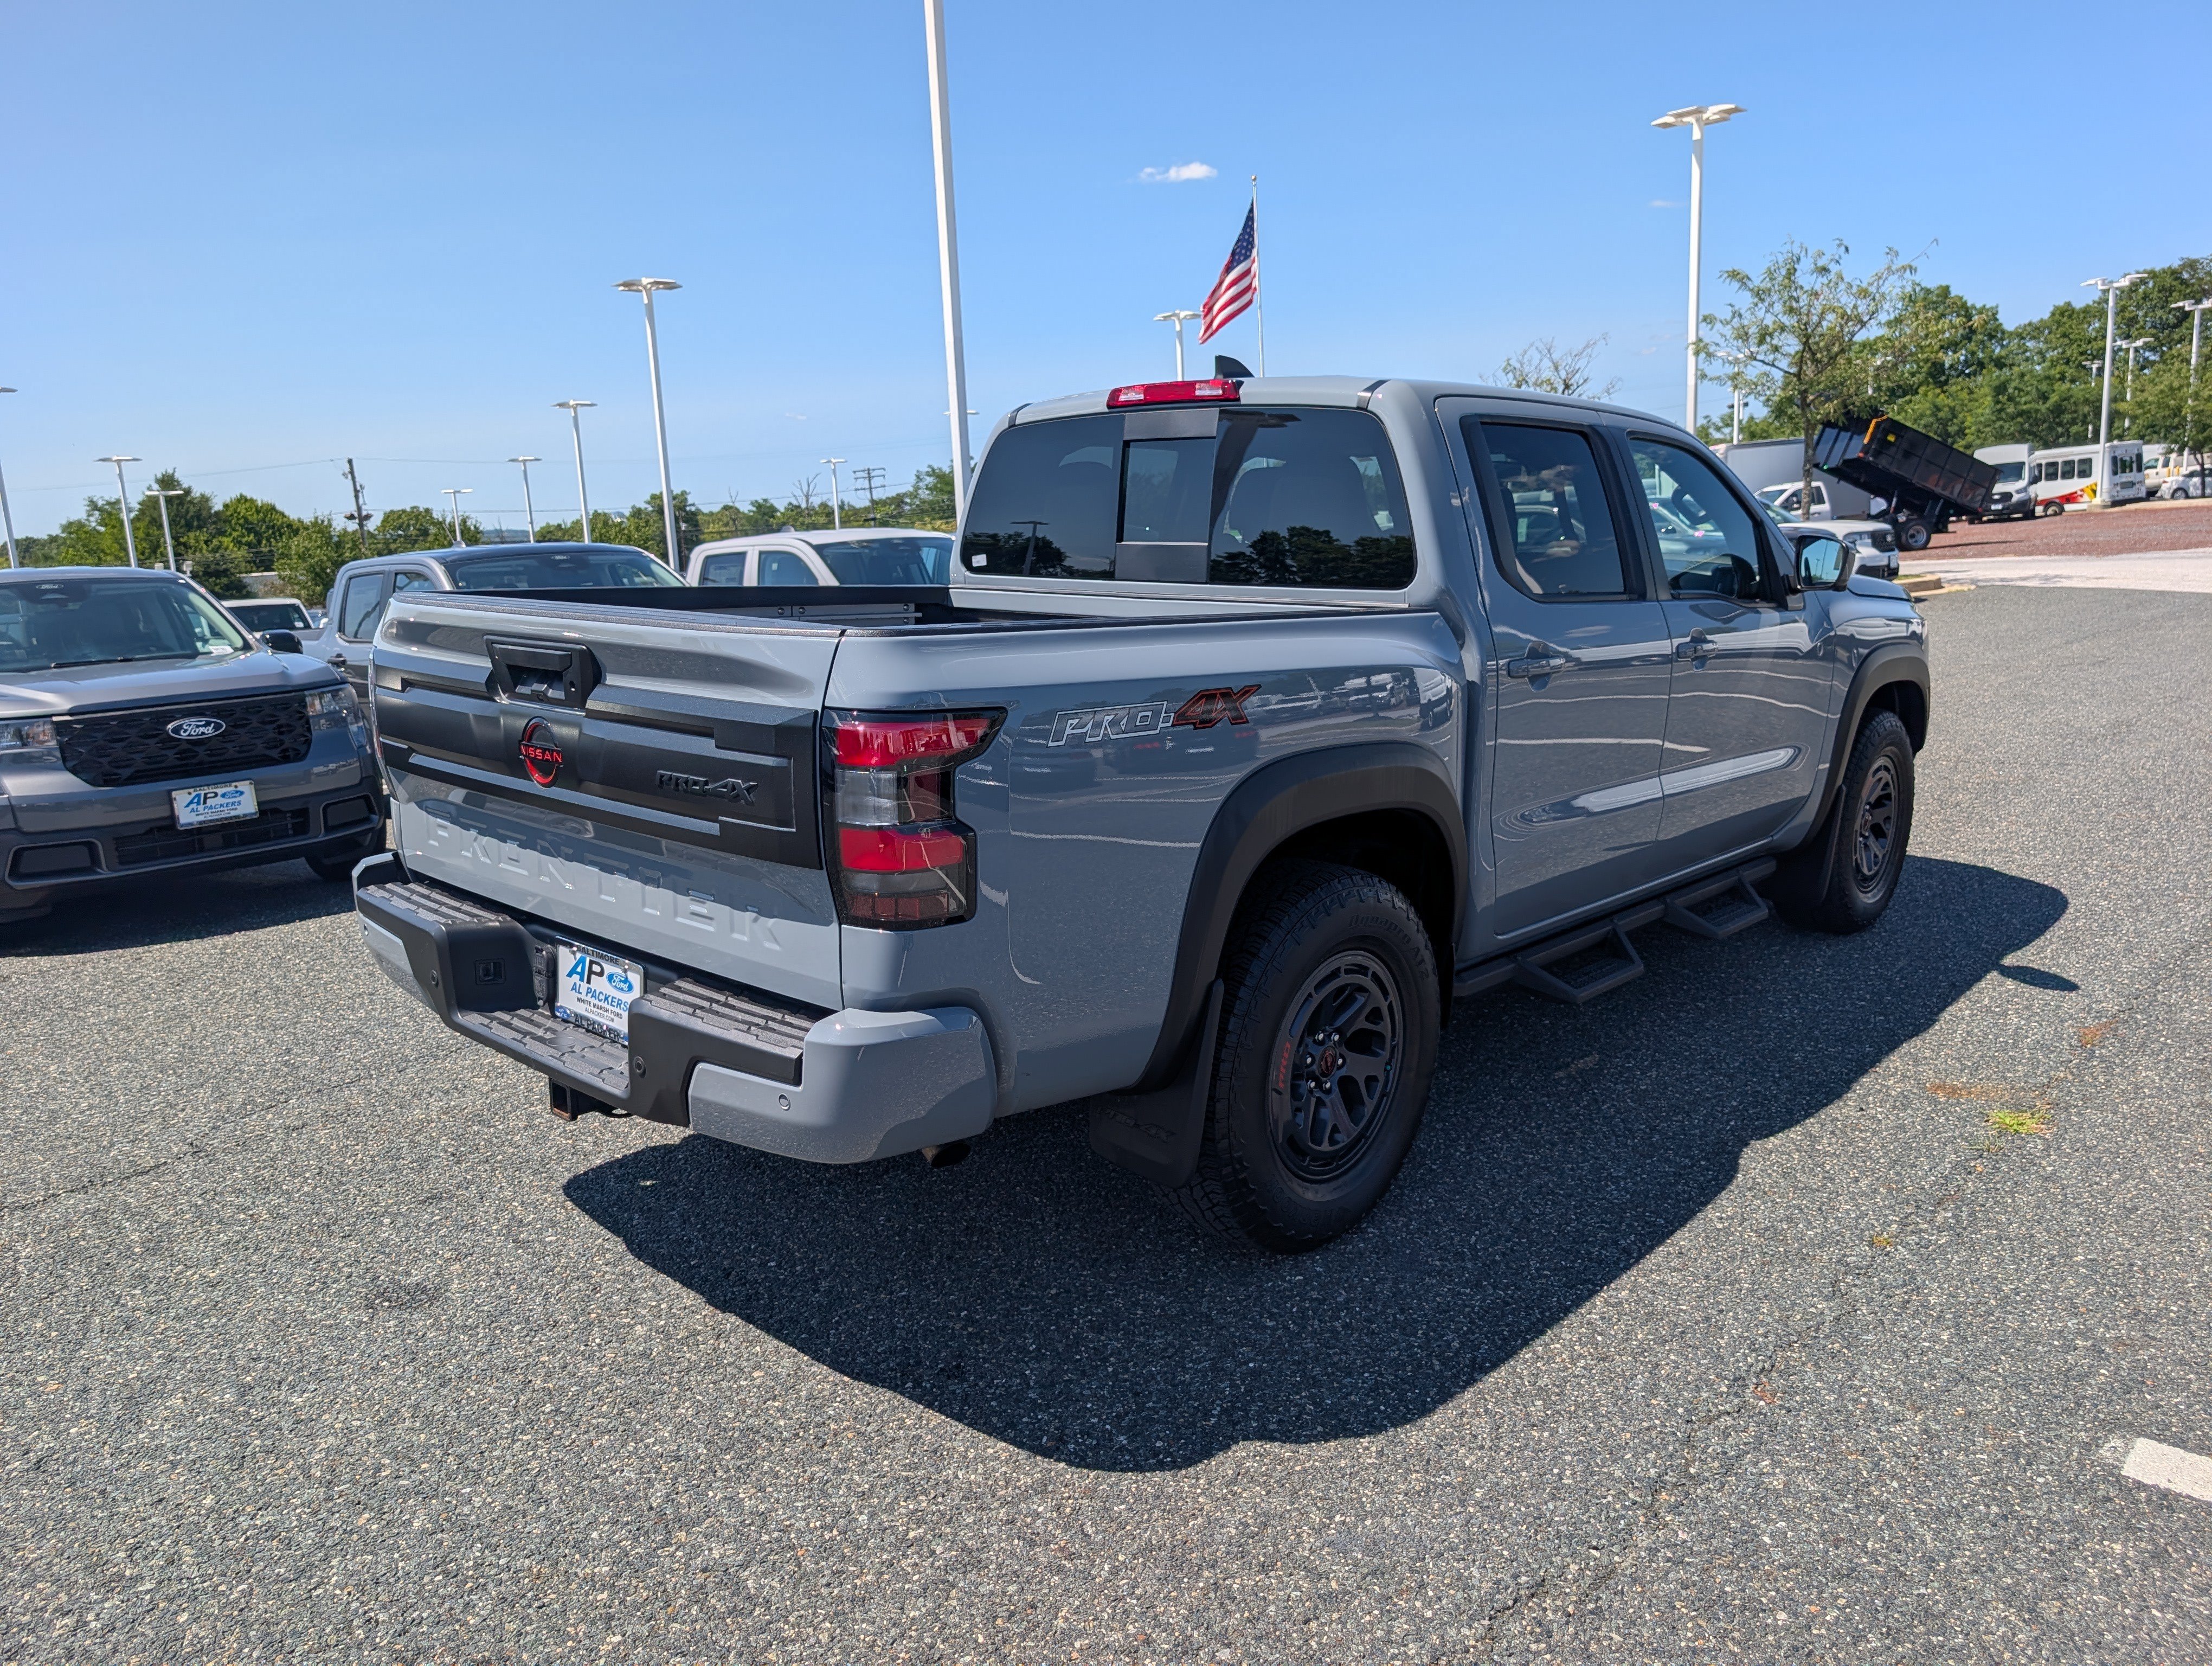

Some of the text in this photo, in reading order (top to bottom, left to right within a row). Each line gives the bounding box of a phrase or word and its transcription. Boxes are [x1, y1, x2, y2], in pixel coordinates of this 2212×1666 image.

[180, 721, 215, 736] Ford
[1046, 684, 1262, 748] PRO-4X
[520, 744, 562, 762] NISSAN
[184, 791, 218, 809] AP
[657, 770, 759, 807] PRO-4X
[203, 800, 242, 811] PACKERS
[424, 804, 782, 952] FRONTIER
[576, 944, 620, 966] BALTIMORE
[1349, 914, 1429, 981] Dynapro AT2
[566, 955, 629, 992] AP Ford
[570, 982, 583, 995] AL
[586, 986, 629, 1013] PACKERS
[576, 996, 623, 1020] WHITE MARSH FORD
[574, 1014, 620, 1040] AL PACKER
[584, 1007, 615, 1023] ALPACKER.COM
